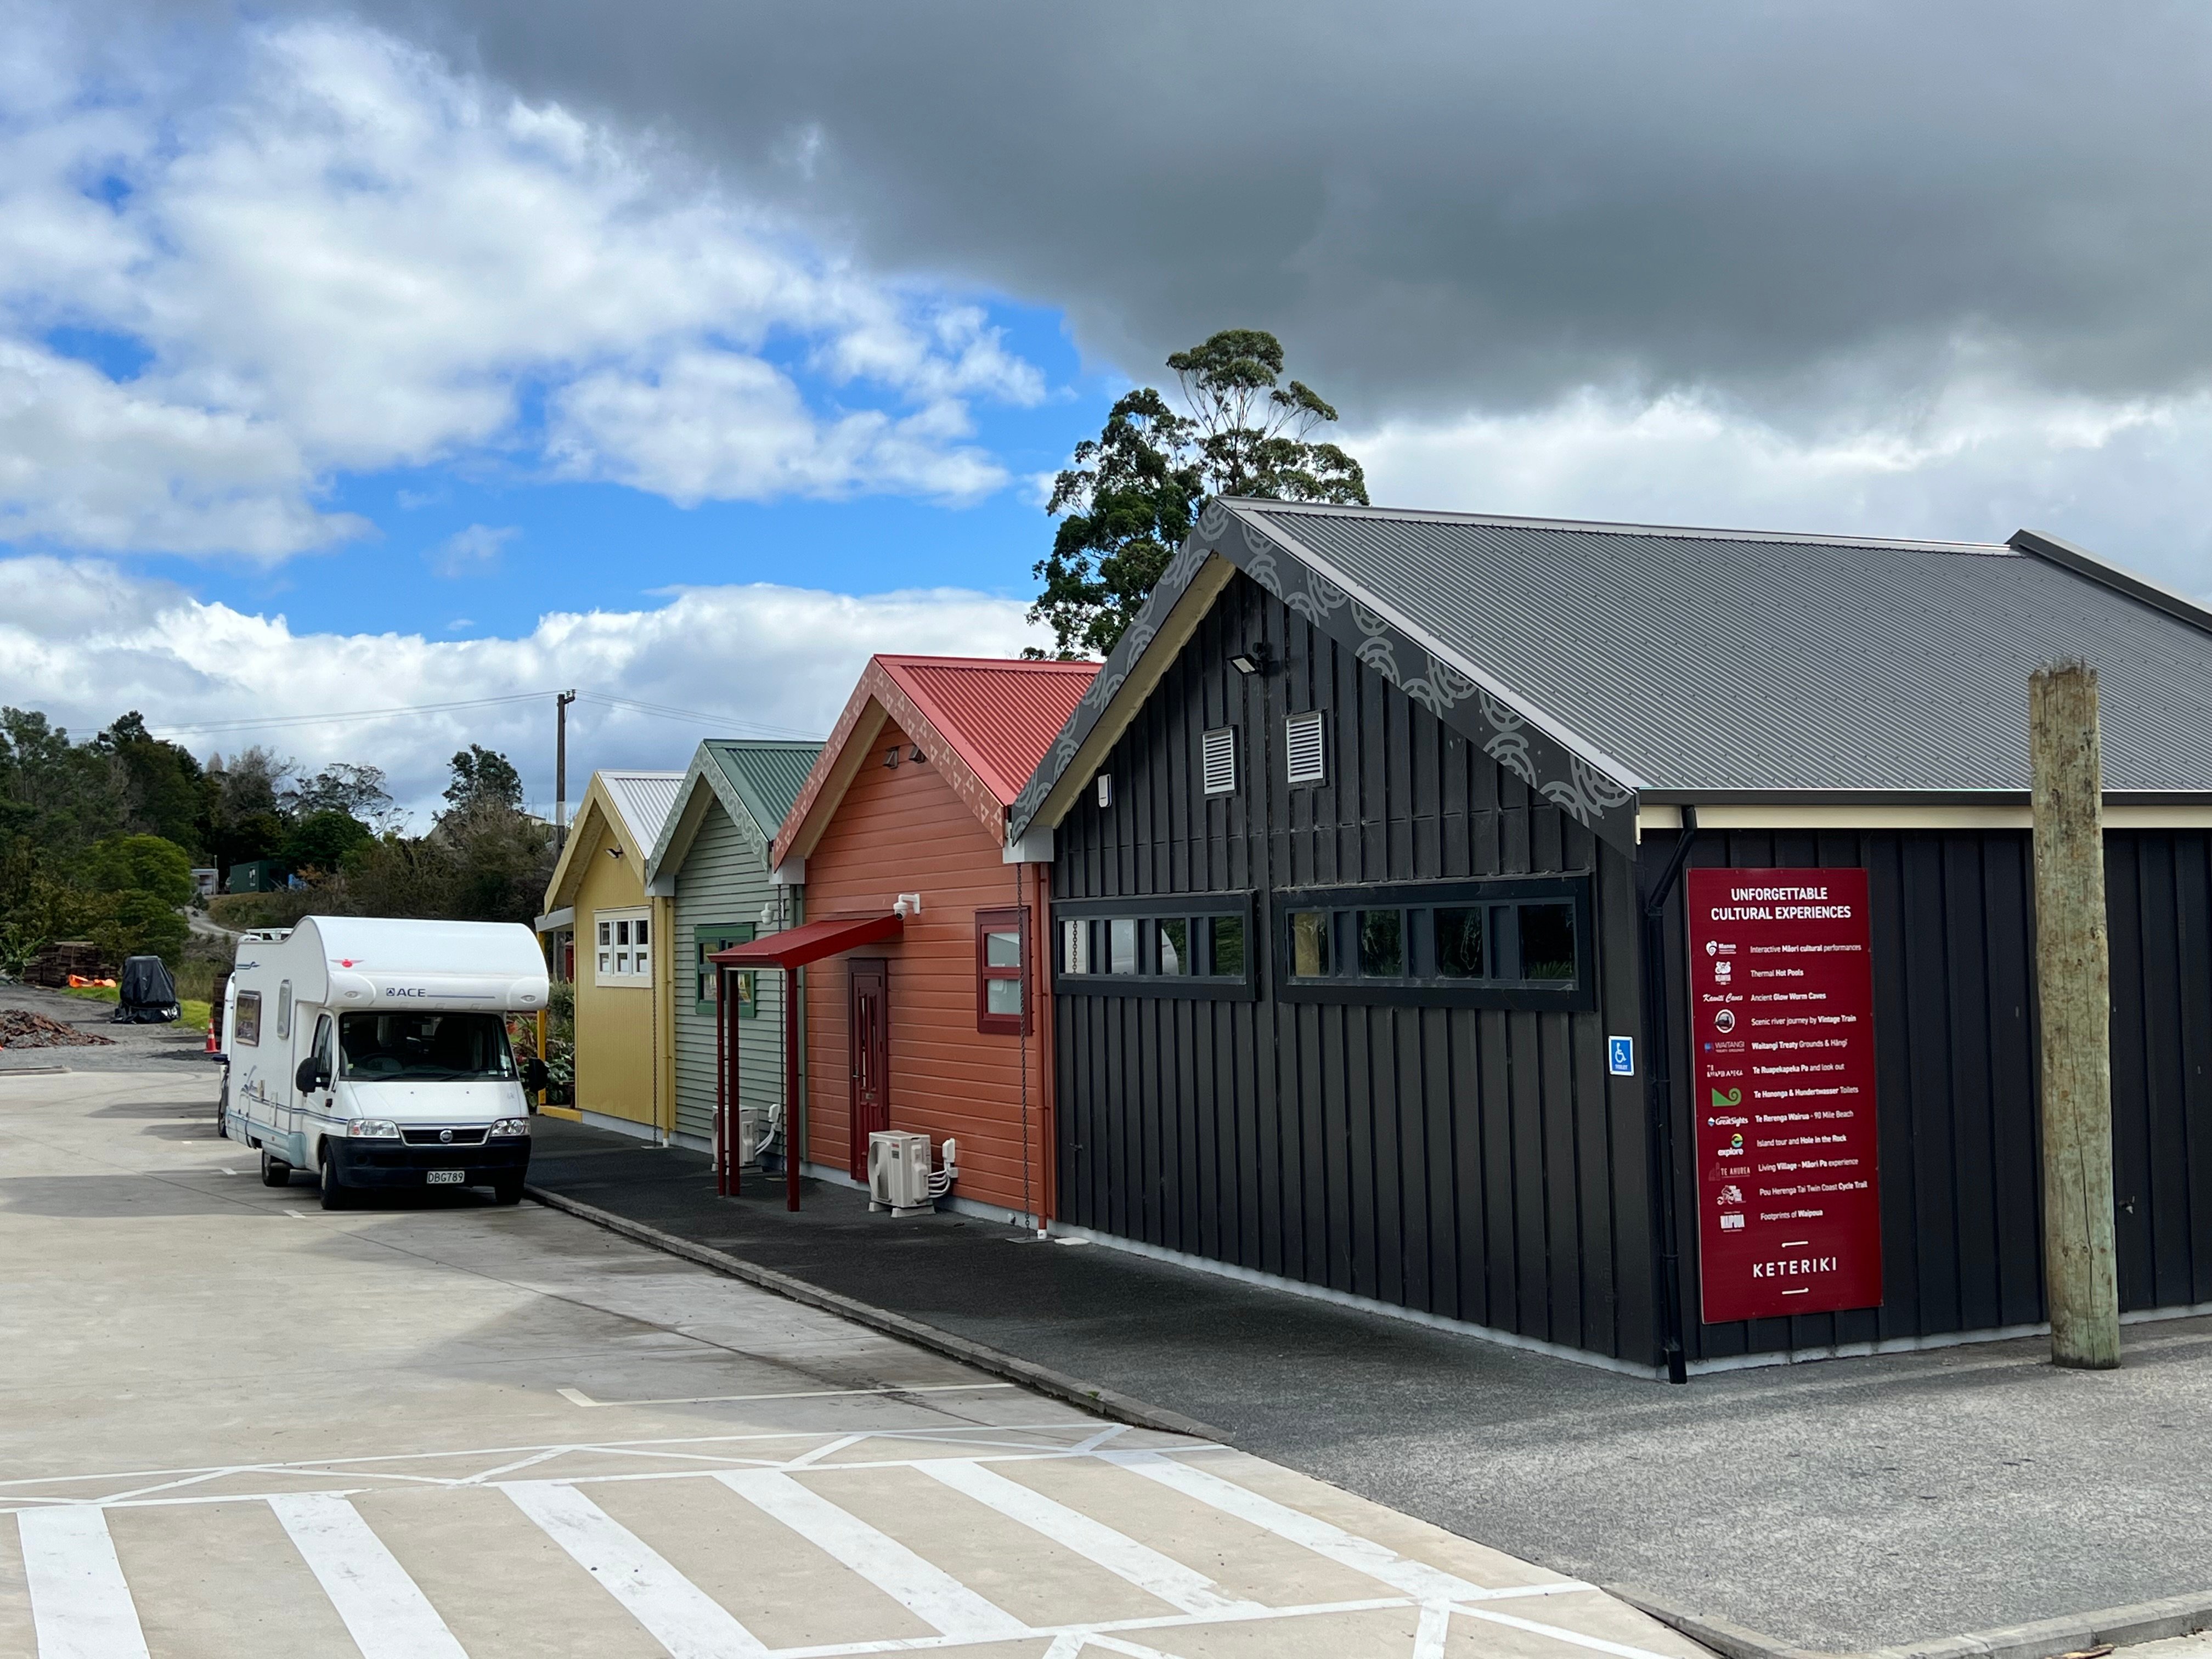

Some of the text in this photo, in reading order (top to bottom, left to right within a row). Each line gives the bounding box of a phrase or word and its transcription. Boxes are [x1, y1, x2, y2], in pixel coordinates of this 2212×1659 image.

[1731, 887, 1827, 901] UNFORGETTABLE
[1711, 906, 1851, 921] CULTURAL EXPERIENCES
[1751, 945, 1781, 953] Interactive
[1799, 944, 1822, 952] cultural
[1824, 944, 1861, 952] performances
[1787, 968, 1804, 977] Pools
[397, 988, 426, 997] ACE
[1787, 1017, 1808, 1026] journey
[1809, 1017, 1816, 1025] by
[1818, 1015, 1840, 1024] Vintage
[1752, 1042, 1778, 1051] Waitangi
[1779, 1041, 1798, 1049] Treaty
[1795, 1088, 1839, 1096] Hundertwasser
[1788, 1113, 1809, 1121] Wairua
[1836, 1110, 1854, 1118] Beach
[1757, 1138, 1774, 1147] Island
[1832, 1134, 1847, 1142] Rock
[1758, 1164, 1776, 1172] Living
[1776, 1163, 1797, 1171] Village
[1829, 1159, 1858, 1167] experience
[428, 1172, 463, 1182] DBG789
[1838, 1182, 1853, 1191] Cycle
[1760, 1212, 1790, 1221] Footprints
[1753, 1257, 1836, 1278] KETERIKI
